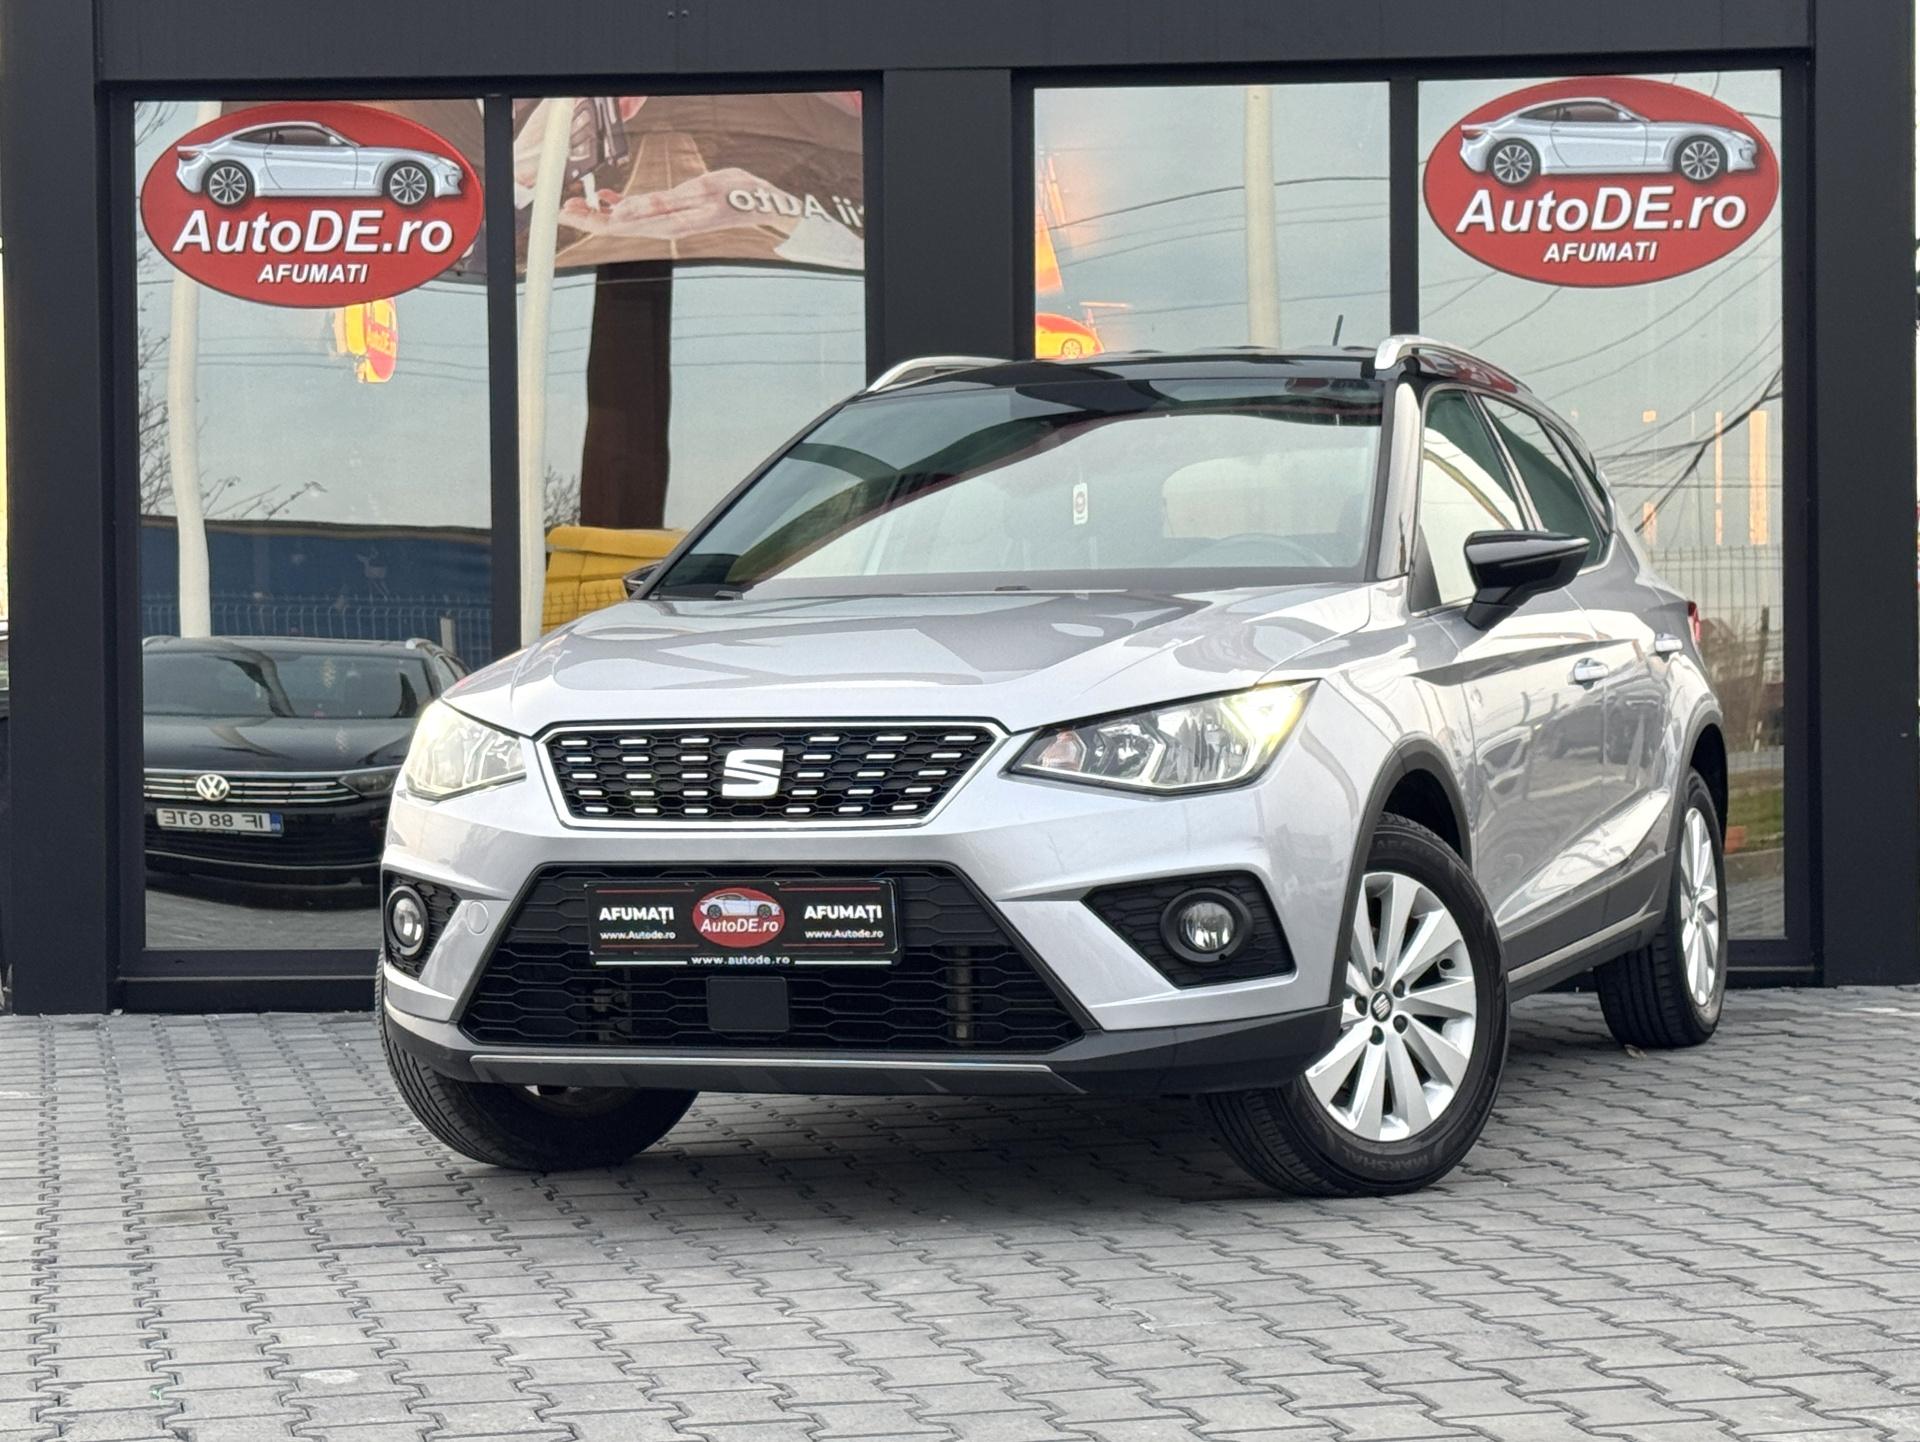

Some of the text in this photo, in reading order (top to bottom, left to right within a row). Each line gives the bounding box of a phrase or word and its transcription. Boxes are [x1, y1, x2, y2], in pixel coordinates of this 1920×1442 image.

[1455, 185, 1748, 234] AutoDE.ro
[172, 208, 454, 254] AutoDE.ro
[1542, 241, 1658, 264] AFUMATI
[257, 263, 369, 284] AFUMATI
[700, 918, 779, 933] AutoDE.ro
[804, 928, 884, 939] www.Autode.ro
[600, 930, 677, 940] www.Autode.ro
[691, 955, 791, 965] www.autode.ro
